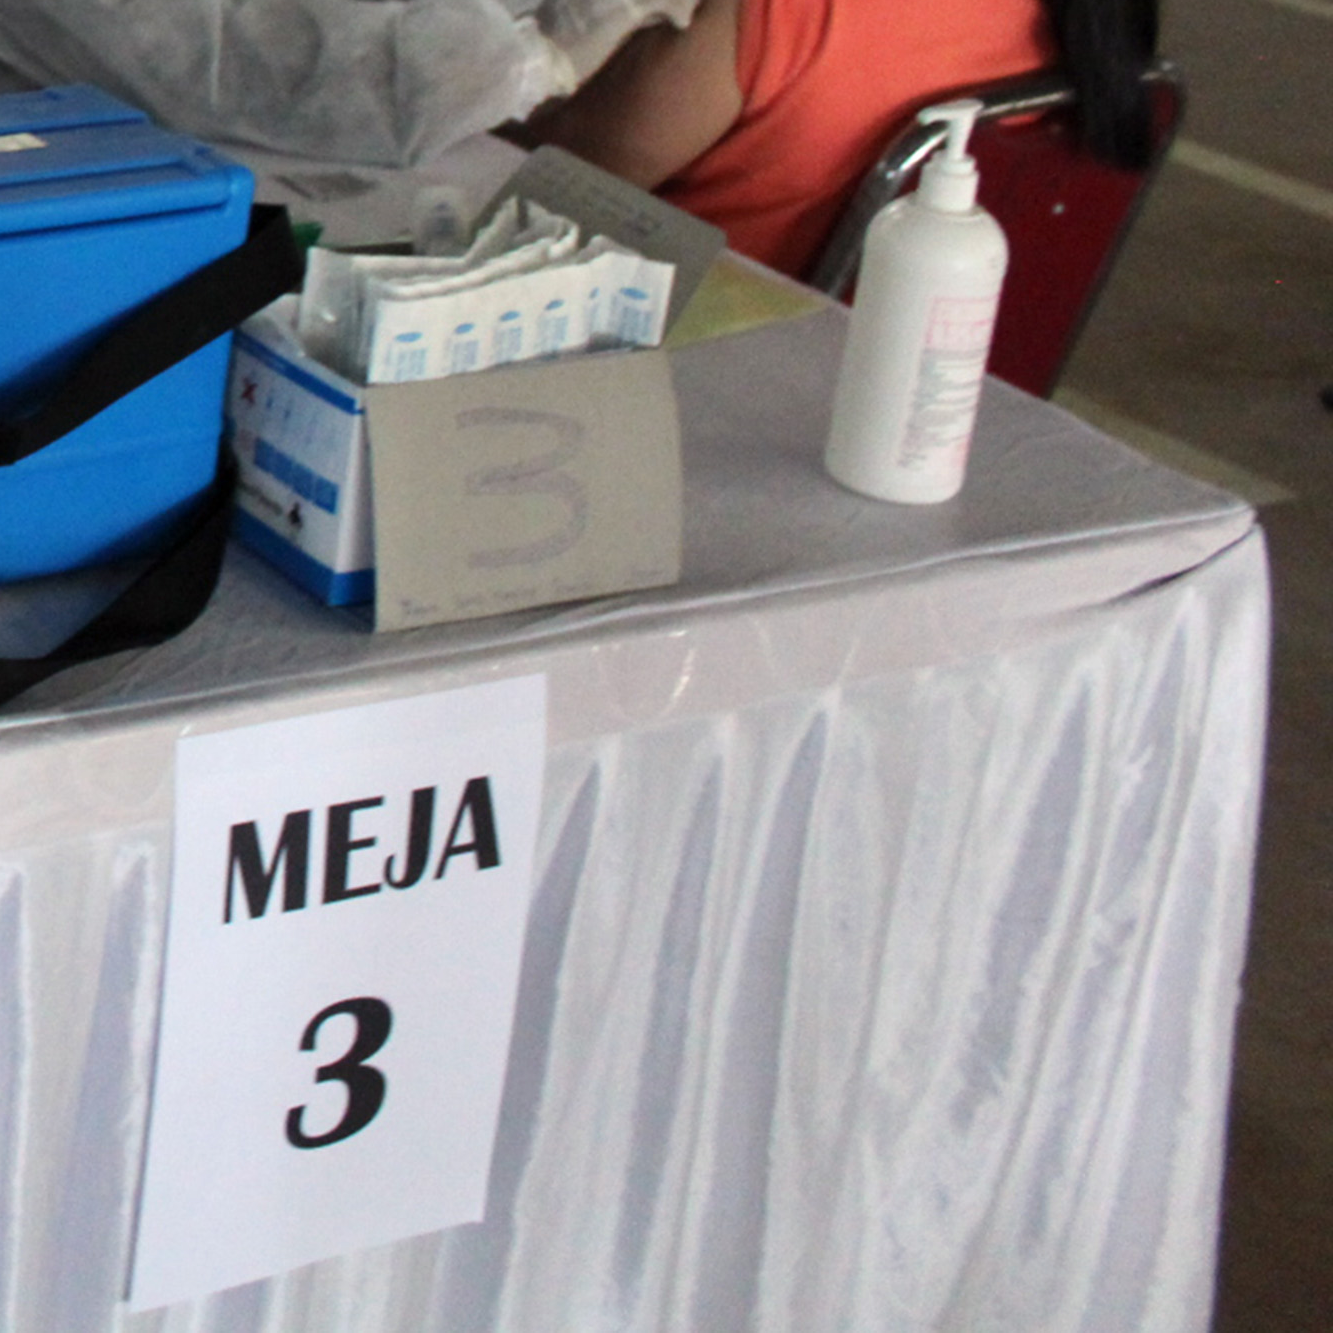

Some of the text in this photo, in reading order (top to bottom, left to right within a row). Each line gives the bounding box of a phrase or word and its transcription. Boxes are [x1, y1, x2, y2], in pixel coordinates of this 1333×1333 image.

[455, 404, 591, 571] 3
[222, 775, 502, 925] MEJA
[283, 996, 394, 1151] 3
